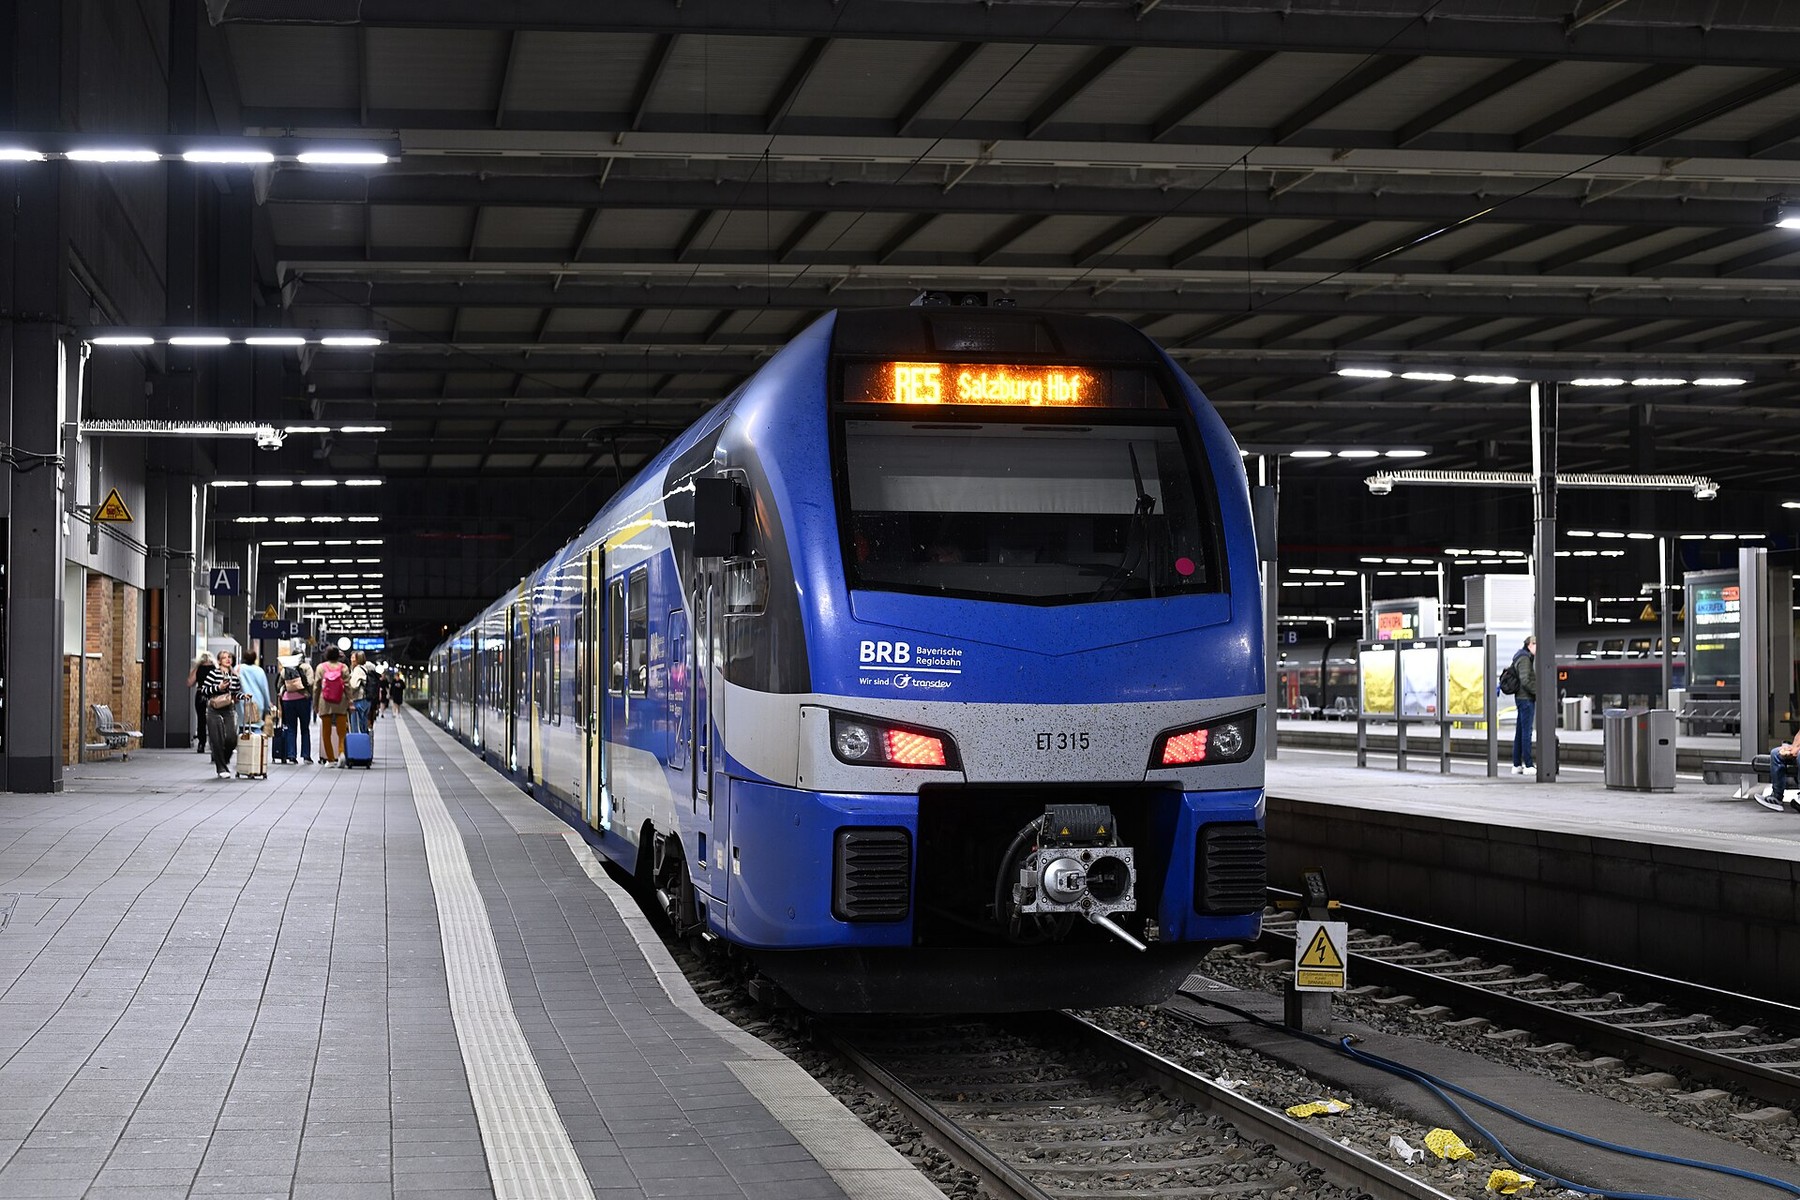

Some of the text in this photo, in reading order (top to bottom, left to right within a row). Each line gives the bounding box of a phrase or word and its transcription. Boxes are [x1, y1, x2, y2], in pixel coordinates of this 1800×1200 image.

[895, 367, 1080, 405] RE5 Salzburg Hbf
[214, 569, 231, 590] A
[262, 621, 279, 629] 5-10
[290, 622, 299, 635] B
[1288, 631, 1297, 643] B
[860, 640, 910, 664] BRB
[916, 646, 963, 656] Bayerische
[916, 657, 961, 667] Regiobahn
[874, 678, 890, 686] sind
[912, 679, 952, 688] transdev
[1037, 732, 1090, 750] ET 315
